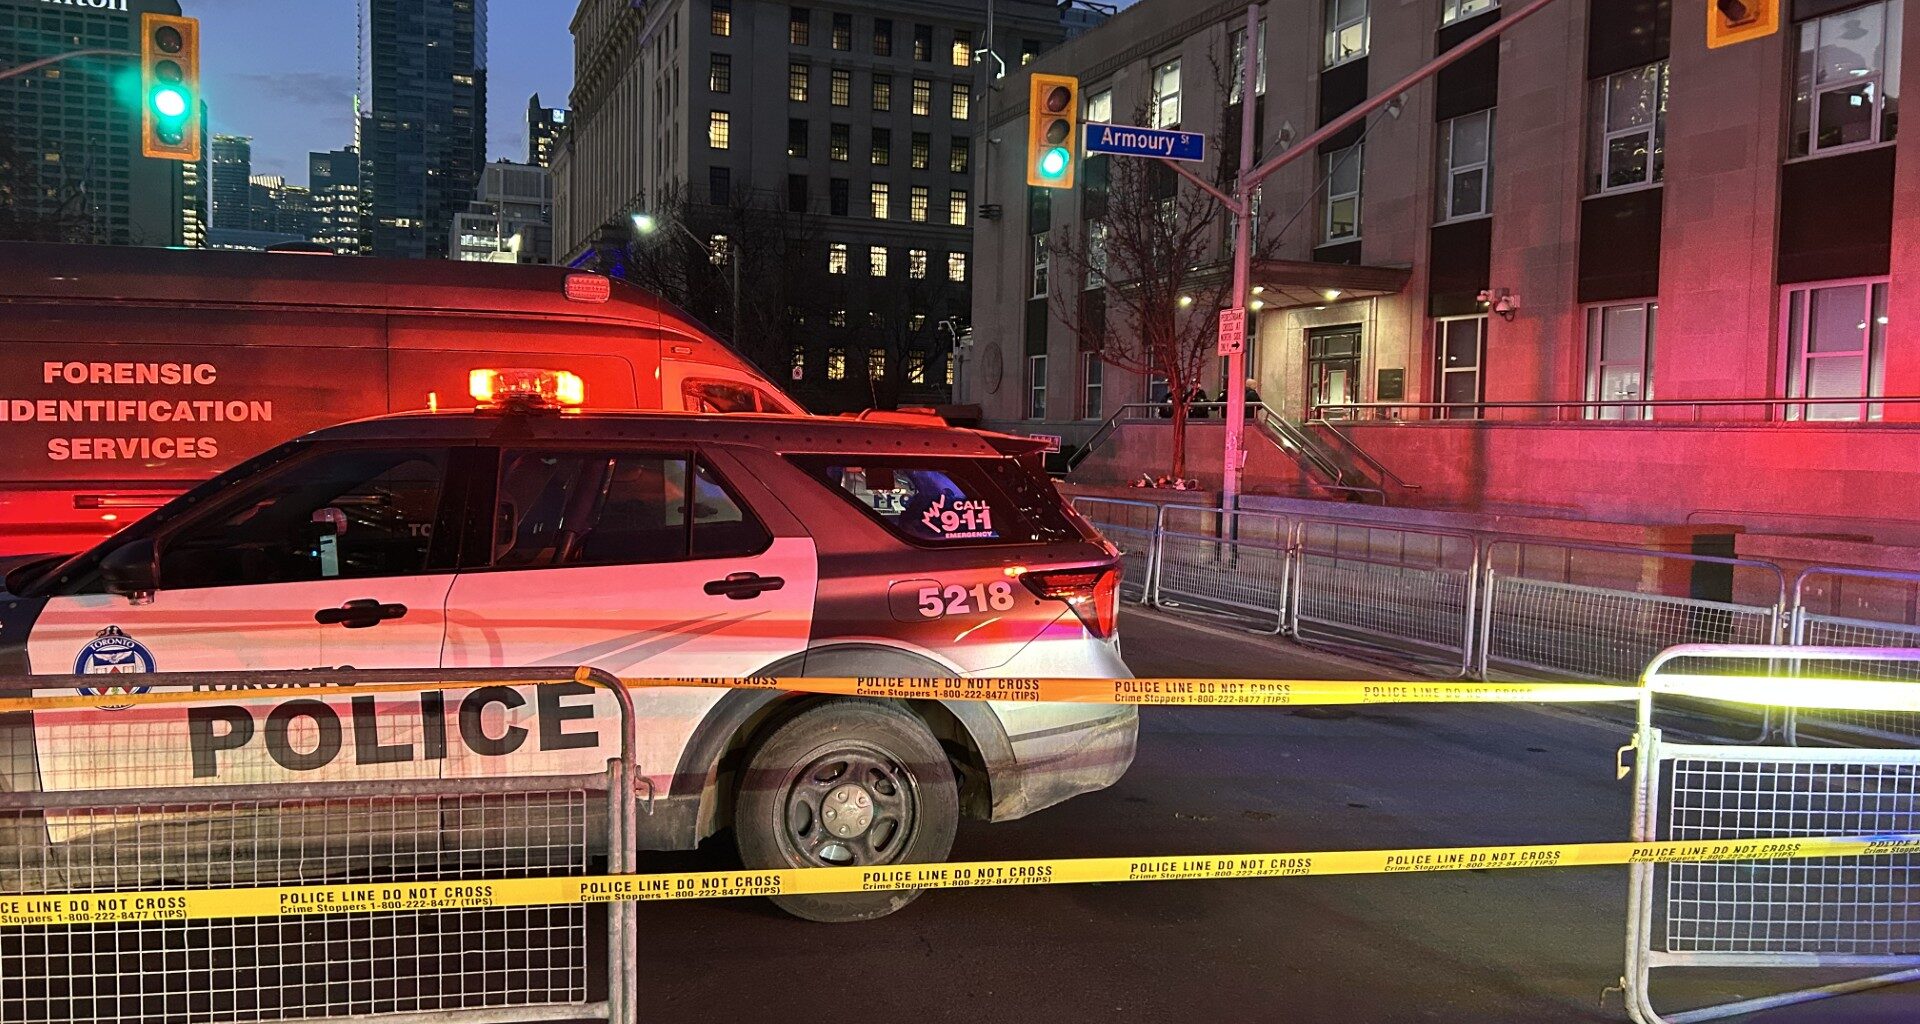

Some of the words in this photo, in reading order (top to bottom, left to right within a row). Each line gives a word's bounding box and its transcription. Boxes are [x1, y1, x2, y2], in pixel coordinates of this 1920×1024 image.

[1101, 127, 1175, 155] Armoury
[1181, 134, 1190, 145] St
[44, 361, 216, 385] FORENSIC
[0, 400, 272, 422] IDENTIFICATION
[47, 437, 218, 460] SERVICES
[954, 500, 990, 511] CALL
[940, 510, 992, 532] 9-1-1
[945, 531, 993, 539] EMERGENCY
[918, 581, 1015, 618] 5218
[89, 638, 135, 650] TORONTO
[857, 677, 904, 687] POLICE
[910, 678, 939, 688] LINE
[945, 678, 961, 689] DO
[967, 678, 992, 689] NOT
[999, 679, 1040, 690] CROSS
[1115, 681, 1160, 693] POLICE
[1166, 682, 1193, 693] LINE
[1200, 683, 1215, 693] DO
[1221, 683, 1245, 693] NOT
[856, 688, 885, 696] Crime
[888, 689, 930, 698] Stoppers
[933, 690, 1008, 699] 1-800-222-8477
[1011, 691, 1040, 701] (TIPS)
[1115, 694, 1141, 702] Crime
[1144, 694, 1185, 704] Stoppers
[1188, 695, 1260, 703] 1-800-222-8477
[1263, 696, 1290, 704] (TIPS)
[1364, 686, 1407, 697] POLICE
[187, 681, 600, 779] POLICE
[1387, 854, 1432, 865] POLICE
[1438, 853, 1465, 863] LINE
[1470, 853, 1486, 862] DO
[1491, 852, 1516, 861] NOT
[1521, 850, 1561, 860] CROSS
[1632, 848, 1676, 857] POLICE
[1681, 847, 1708, 856] LINE
[1713, 846, 1729, 854] DO
[1734, 846, 1757, 854] NOT
[1762, 844, 1801, 853] CROSS
[1130, 862, 1178, 873] POLICE
[1183, 861, 1212, 871] LINE
[1218, 860, 1234, 870] DO
[1240, 859, 1265, 869] NOT
[1270, 858, 1312, 868] CROSS
[1457, 860, 1528, 868] 1-800-222-8477
[1530, 859, 1558, 867] (TIPS)
[863, 871, 912, 882] POLICE
[918, 870, 948, 881] LINE
[954, 869, 971, 879] DO
[977, 868, 1003, 878] NOT
[1009, 866, 1052, 877] CROSS
[1205, 869, 1280, 877] 1-800-222-8477
[1282, 868, 1310, 876] (TIPS)
[581, 881, 632, 893] POLICE
[639, 880, 670, 891] LINE
[677, 879, 695, 890] DO
[702, 877, 729, 889] NOT
[735, 875, 781, 887] CROSS
[894, 882, 939, 890] Stoppers
[942, 877, 1020, 887] 1-800-222-8477
[1022, 876, 1052, 885] (TIPS)
[280, 892, 335, 904] POLICE
[342, 890, 375, 902] LINE
[383, 889, 401, 900] DO
[409, 888, 437, 899] NOT
[444, 885, 493, 898] CROSS
[580, 893, 611, 902] Crime
[614, 892, 661, 901] Stoppers
[664, 888, 746, 898] 1-800-222-8477
[750, 886, 781, 896] (TIPS)
[27, 901, 62, 913] LINE
[70, 900, 90, 912] DO
[98, 898, 128, 911] NOT
[136, 896, 187, 909] CROSS
[280, 904, 313, 914] Crime
[316, 903, 367, 913] Stoppers
[370, 899, 457, 910] 1-800-222-8477
[461, 897, 493, 907] (TIPS)
[1, 913, 53, 924] Stoppers
[58, 910, 149, 922] 1-800-222-8477
[153, 909, 187, 920] (TIPS)
